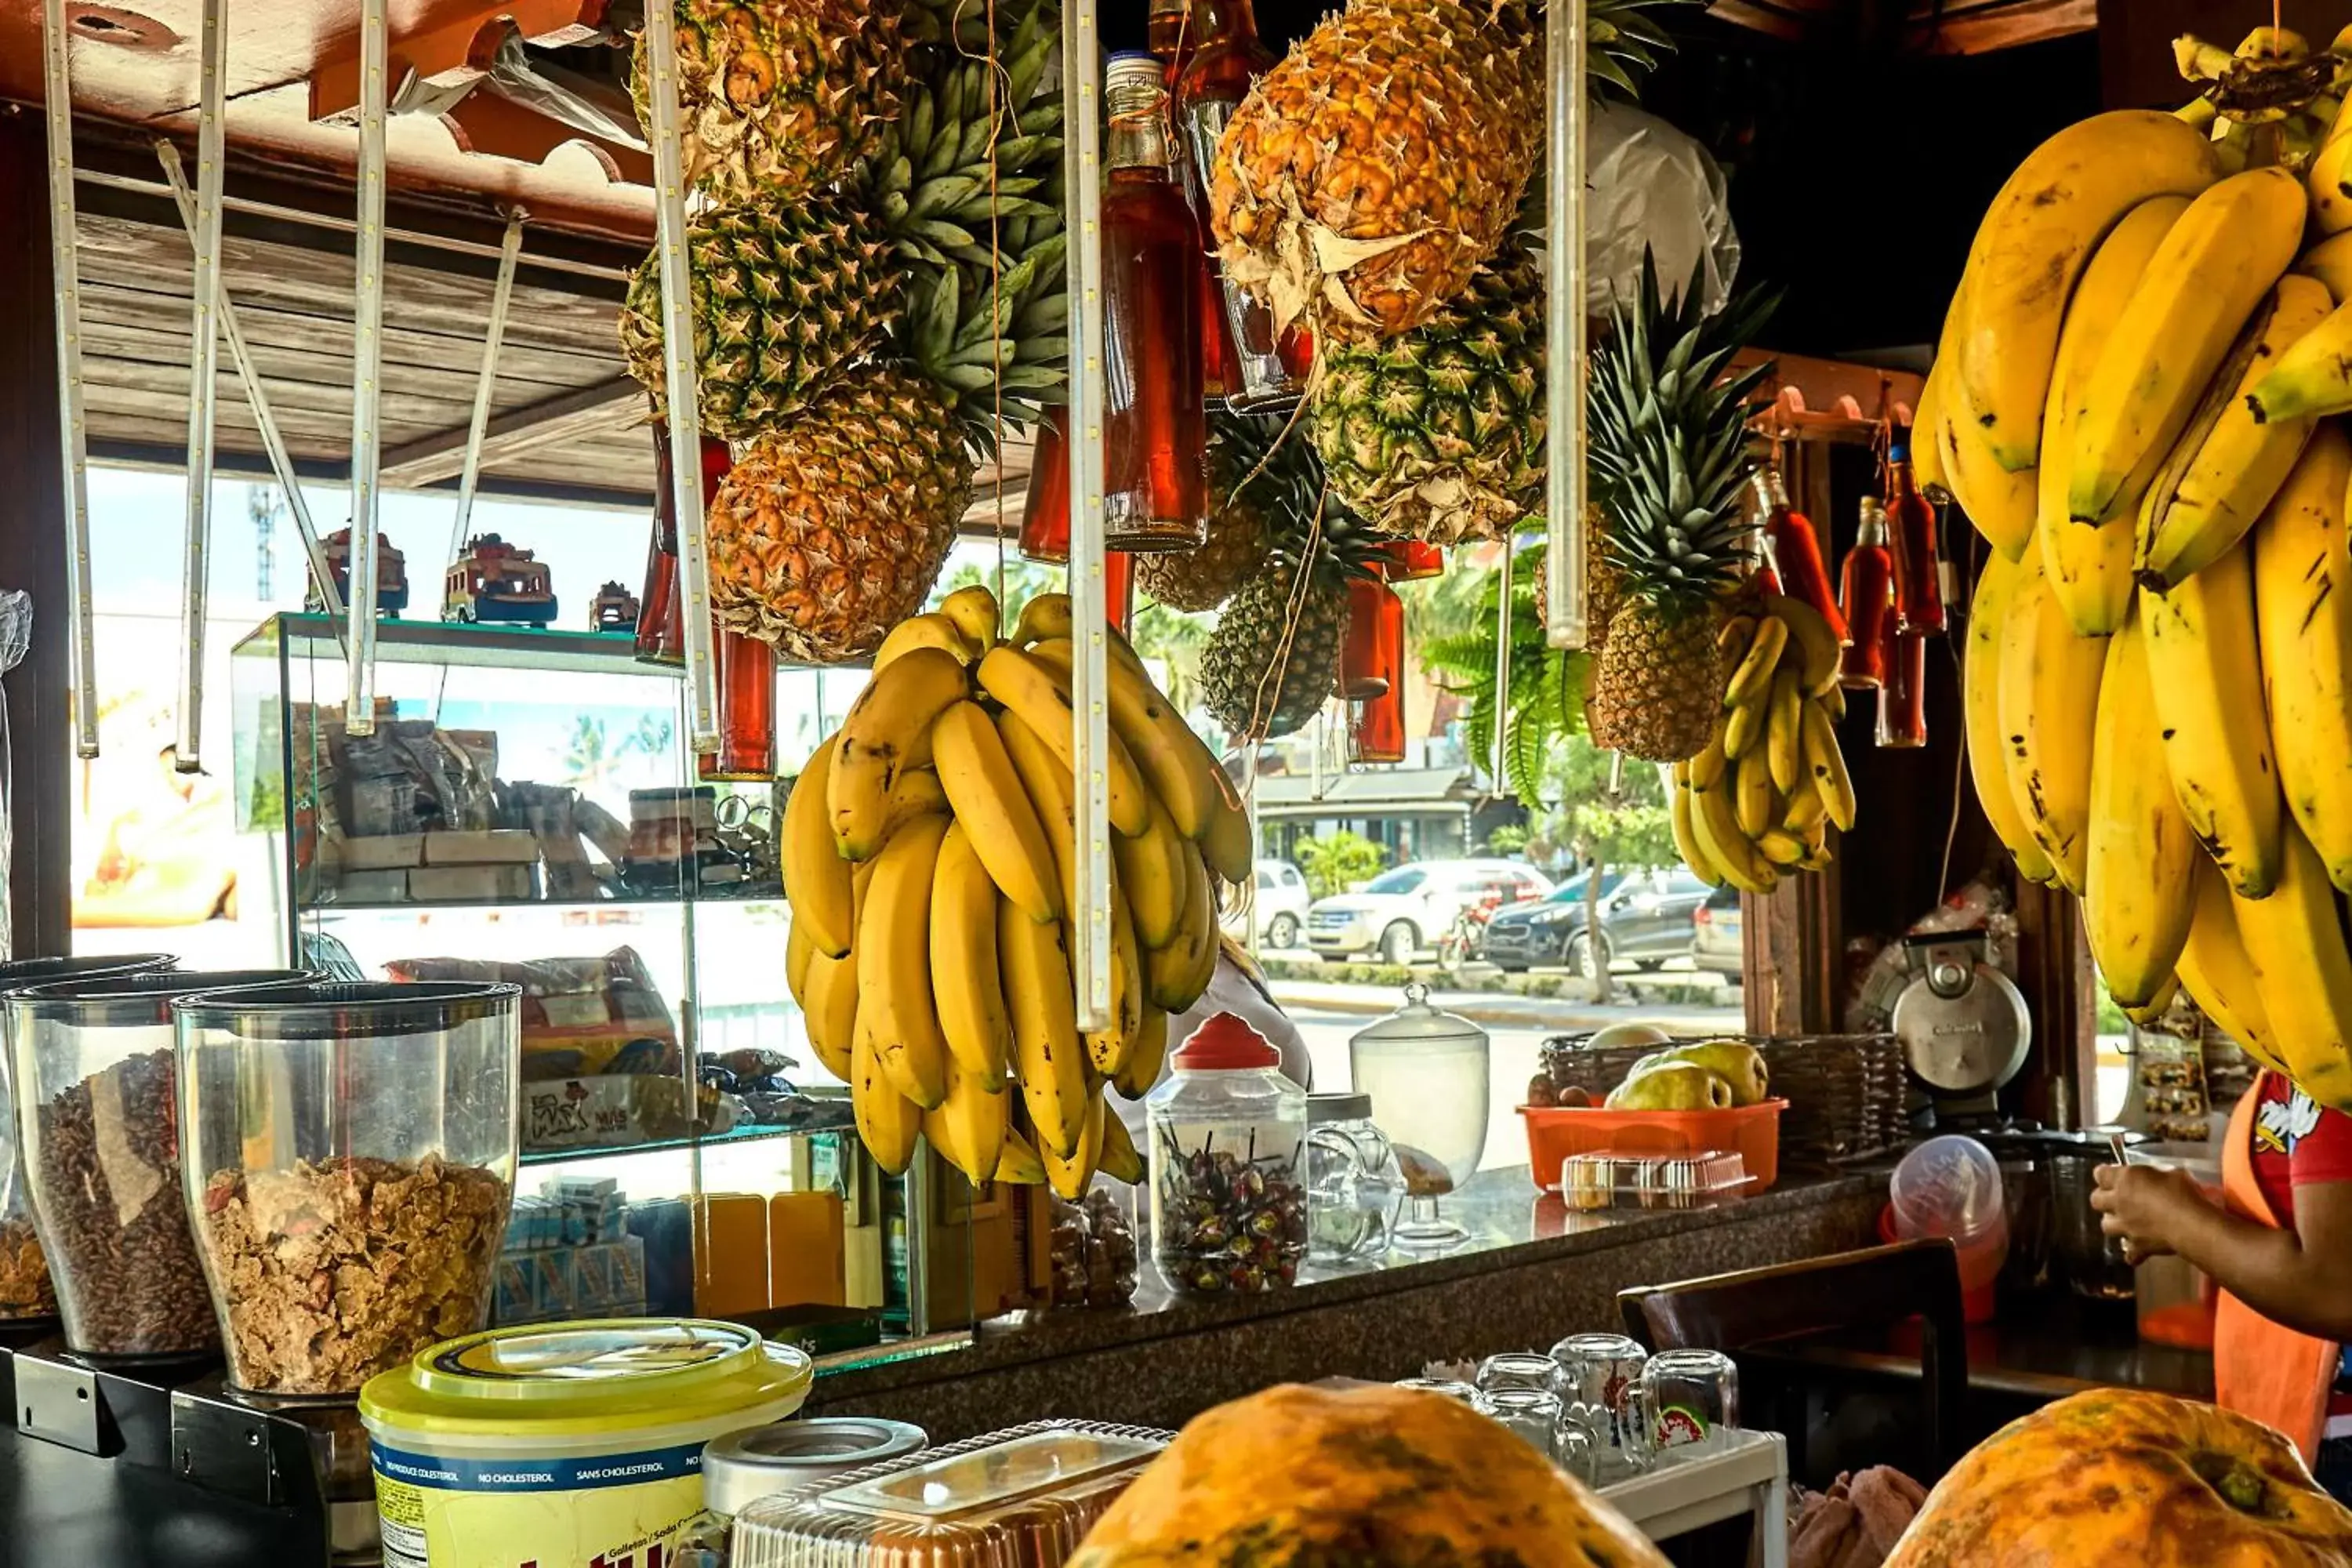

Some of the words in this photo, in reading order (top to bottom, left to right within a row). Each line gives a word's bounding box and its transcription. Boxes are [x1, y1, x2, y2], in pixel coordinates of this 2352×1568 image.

[686, 1456, 699, 1465] NO
[477, 1473, 491, 1483] NO
[492, 1473, 555, 1483] CHOLESTEROL
[576, 1469, 601, 1480] SANS
[601, 1462, 664, 1478] CHOLESTEROL
[608, 1538, 648, 1558] Galletas
[653, 1523, 677, 1540] Soda
